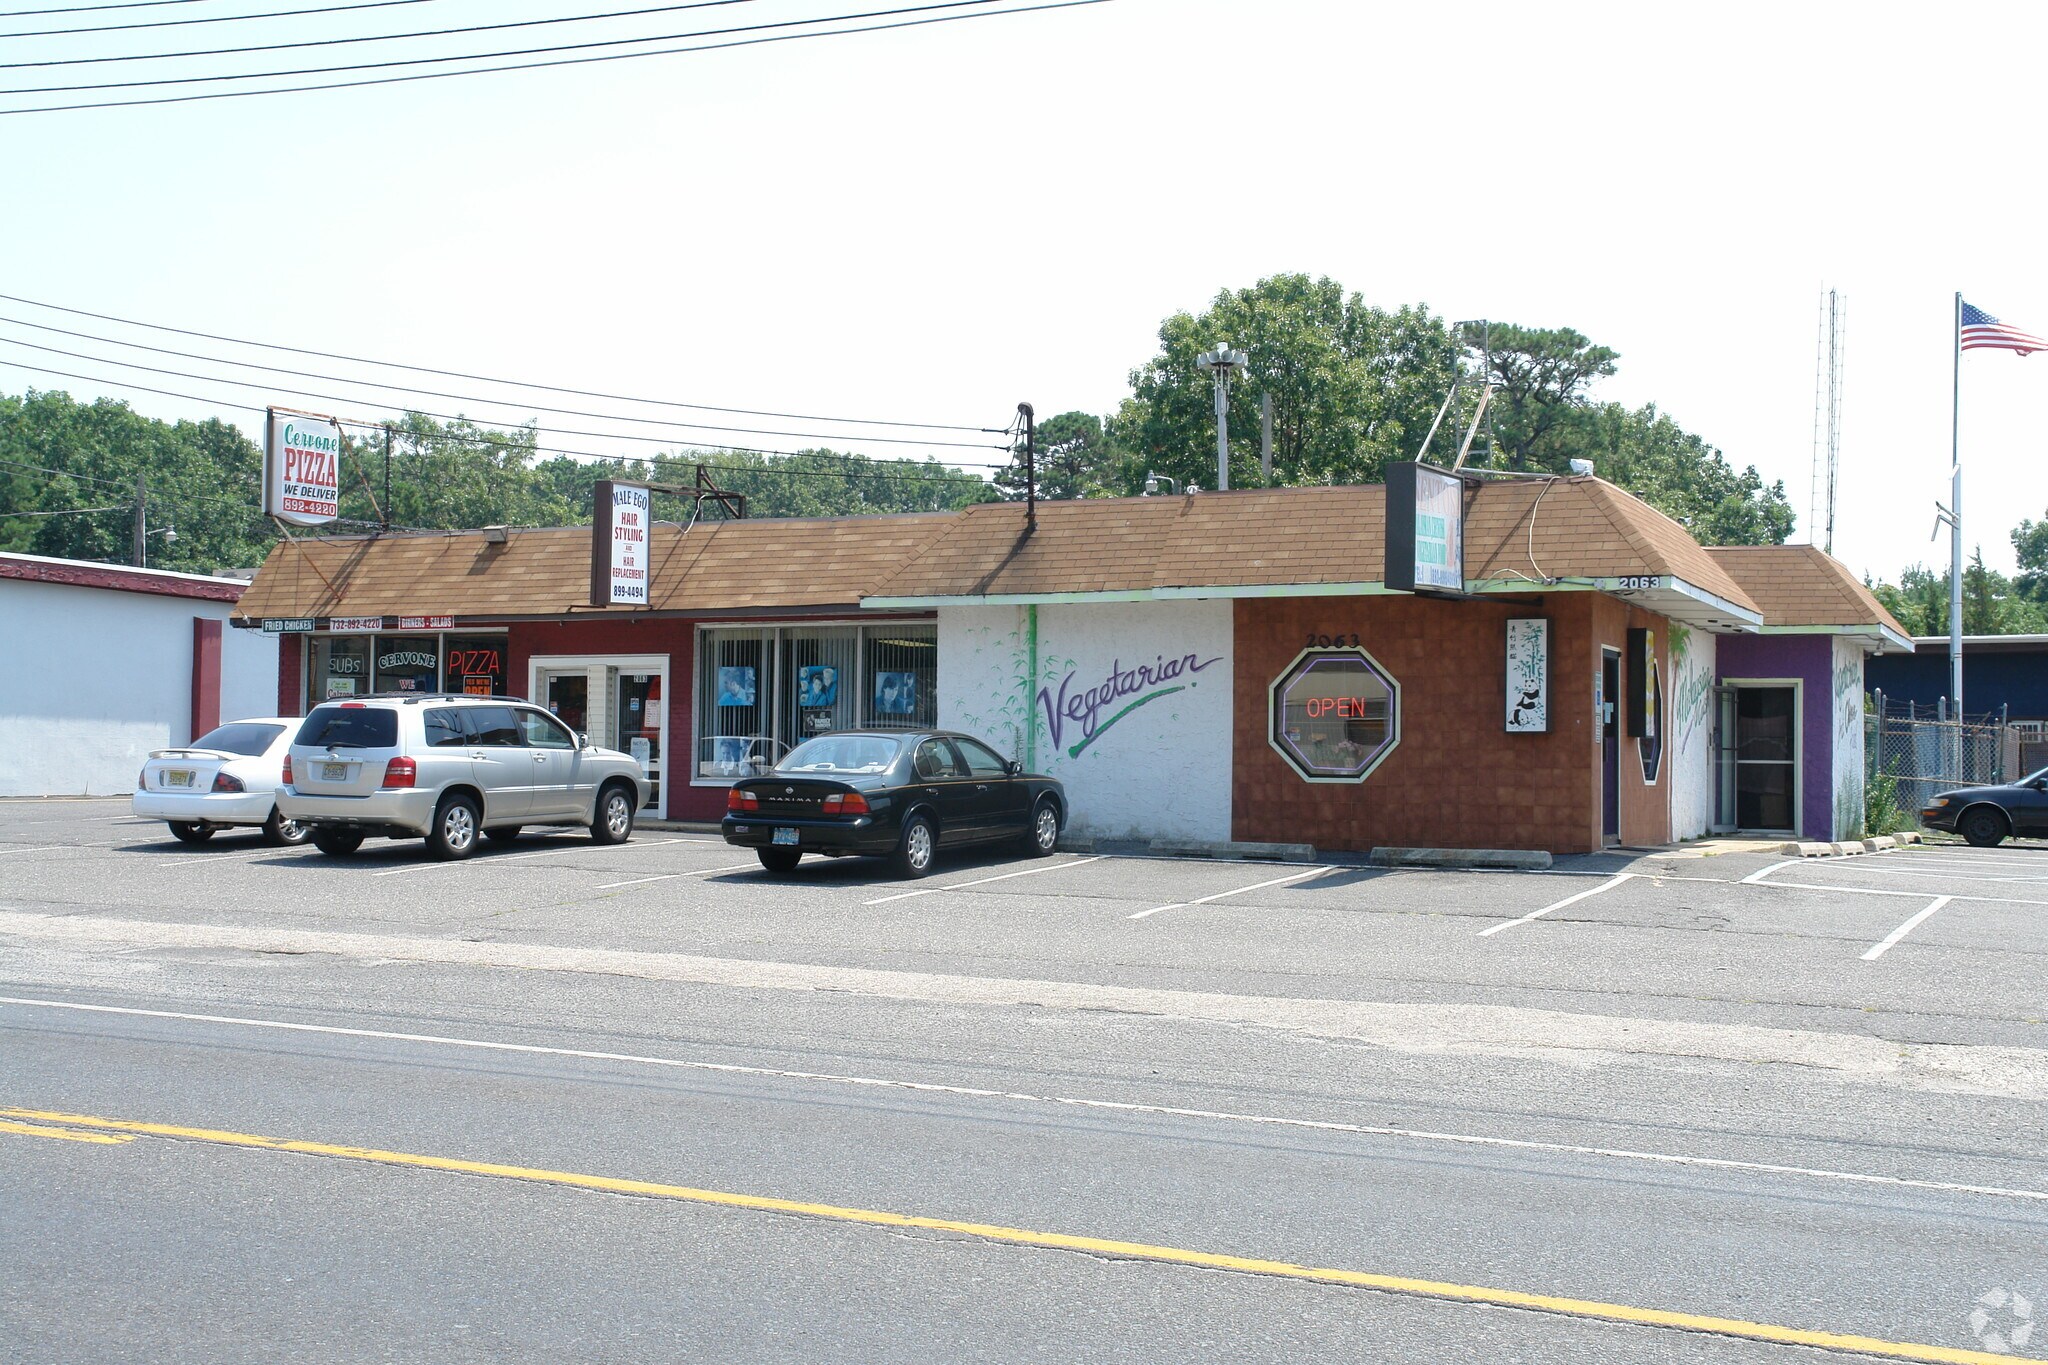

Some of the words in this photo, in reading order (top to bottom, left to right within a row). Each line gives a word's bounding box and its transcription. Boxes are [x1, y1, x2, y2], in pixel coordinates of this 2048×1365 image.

[284, 424, 338, 451] Cervone
[284, 447, 337, 488] PIZZA
[284, 484, 299, 496] WE
[301, 486, 337, 500] DELIVER
[284, 499, 336, 516] 892-4220
[613, 490, 631, 508] MALE
[633, 492, 647, 511] EGO
[621, 512, 638, 527] HAIR
[614, 526, 643, 542] STYLING
[622, 556, 635, 567] HAIR
[612, 567, 644, 580] REPLACEMENT
[1620, 577, 1660, 589] 2063
[613, 585, 643, 598] 899-4494
[264, 620, 284, 632] FRIED
[284, 620, 312, 631] CHICKEN
[332, 618, 380, 630] 732-892-4220
[401, 617, 425, 629] DINNERS
[429, 616, 452, 628] SALADS
[1305, 633, 1361, 649] 2063
[378, 651, 437, 669] CERVONE
[448, 650, 500, 675] PIZZA
[399, 679, 416, 690] WE
[464, 686, 491, 695] OPEN
[1036, 653, 1225, 752] Vegetarian
[1306, 697, 1367, 718] OPEN
